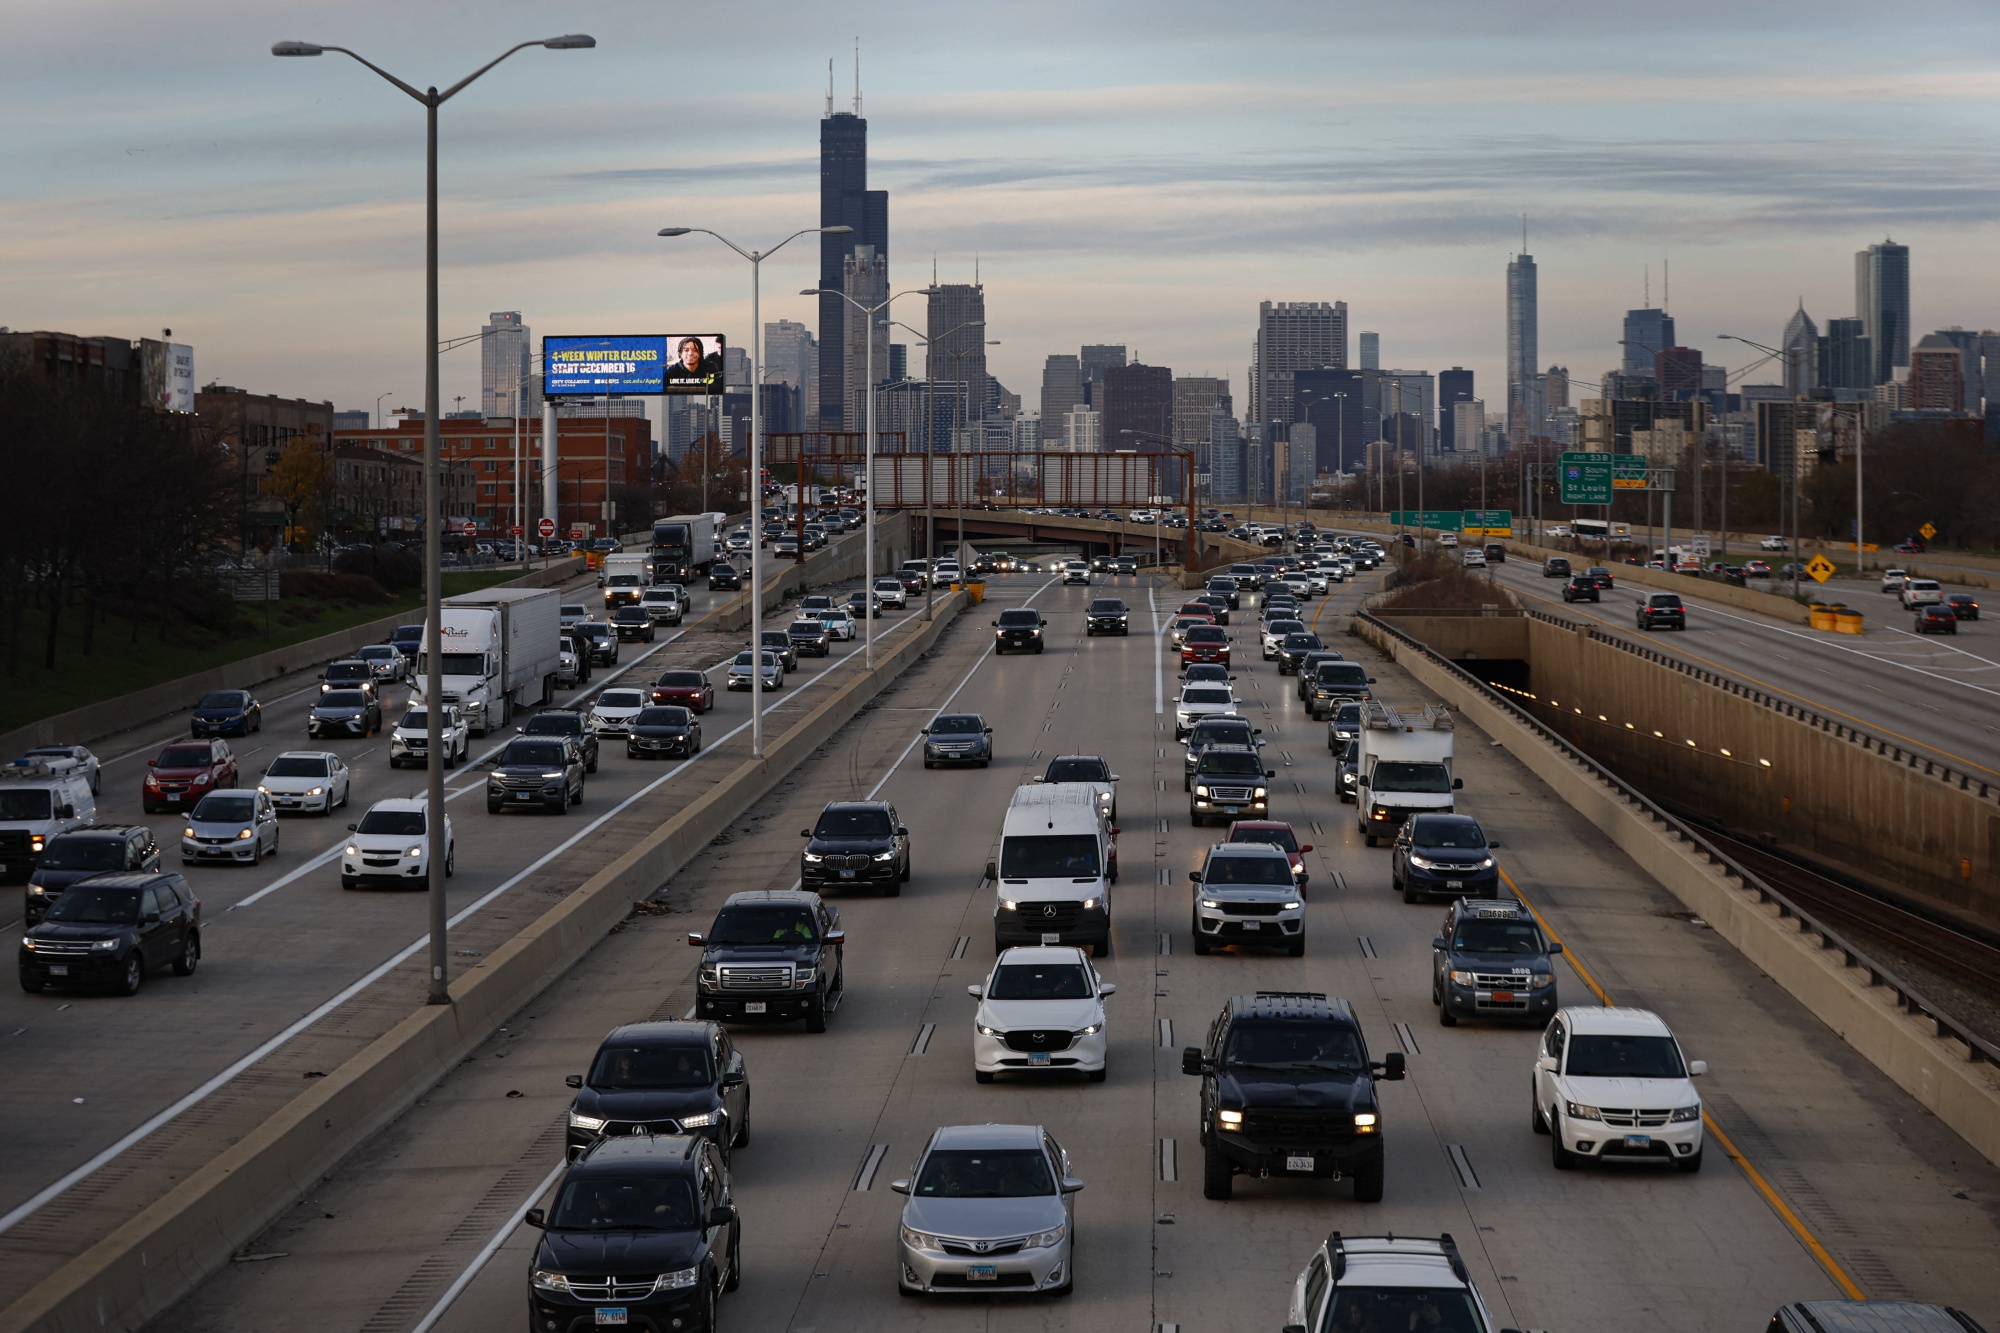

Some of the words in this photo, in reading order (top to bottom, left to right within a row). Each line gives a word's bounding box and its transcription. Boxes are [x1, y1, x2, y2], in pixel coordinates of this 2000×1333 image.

[552, 351, 585, 361] 4-WEEK
[586, 350, 619, 361] WINTER
[621, 350, 657, 361] CLASSES
[552, 363, 579, 374] START
[580, 362, 625, 374] DECEMBER
[626, 363, 636, 373] 16
[1569, 470, 1579, 478] 55
[1567, 484, 1578, 492] St
[1581, 484, 1607, 492] Louis
[1695, 547, 1707, 555] 45
[1489, 910, 1507, 918] 1698
